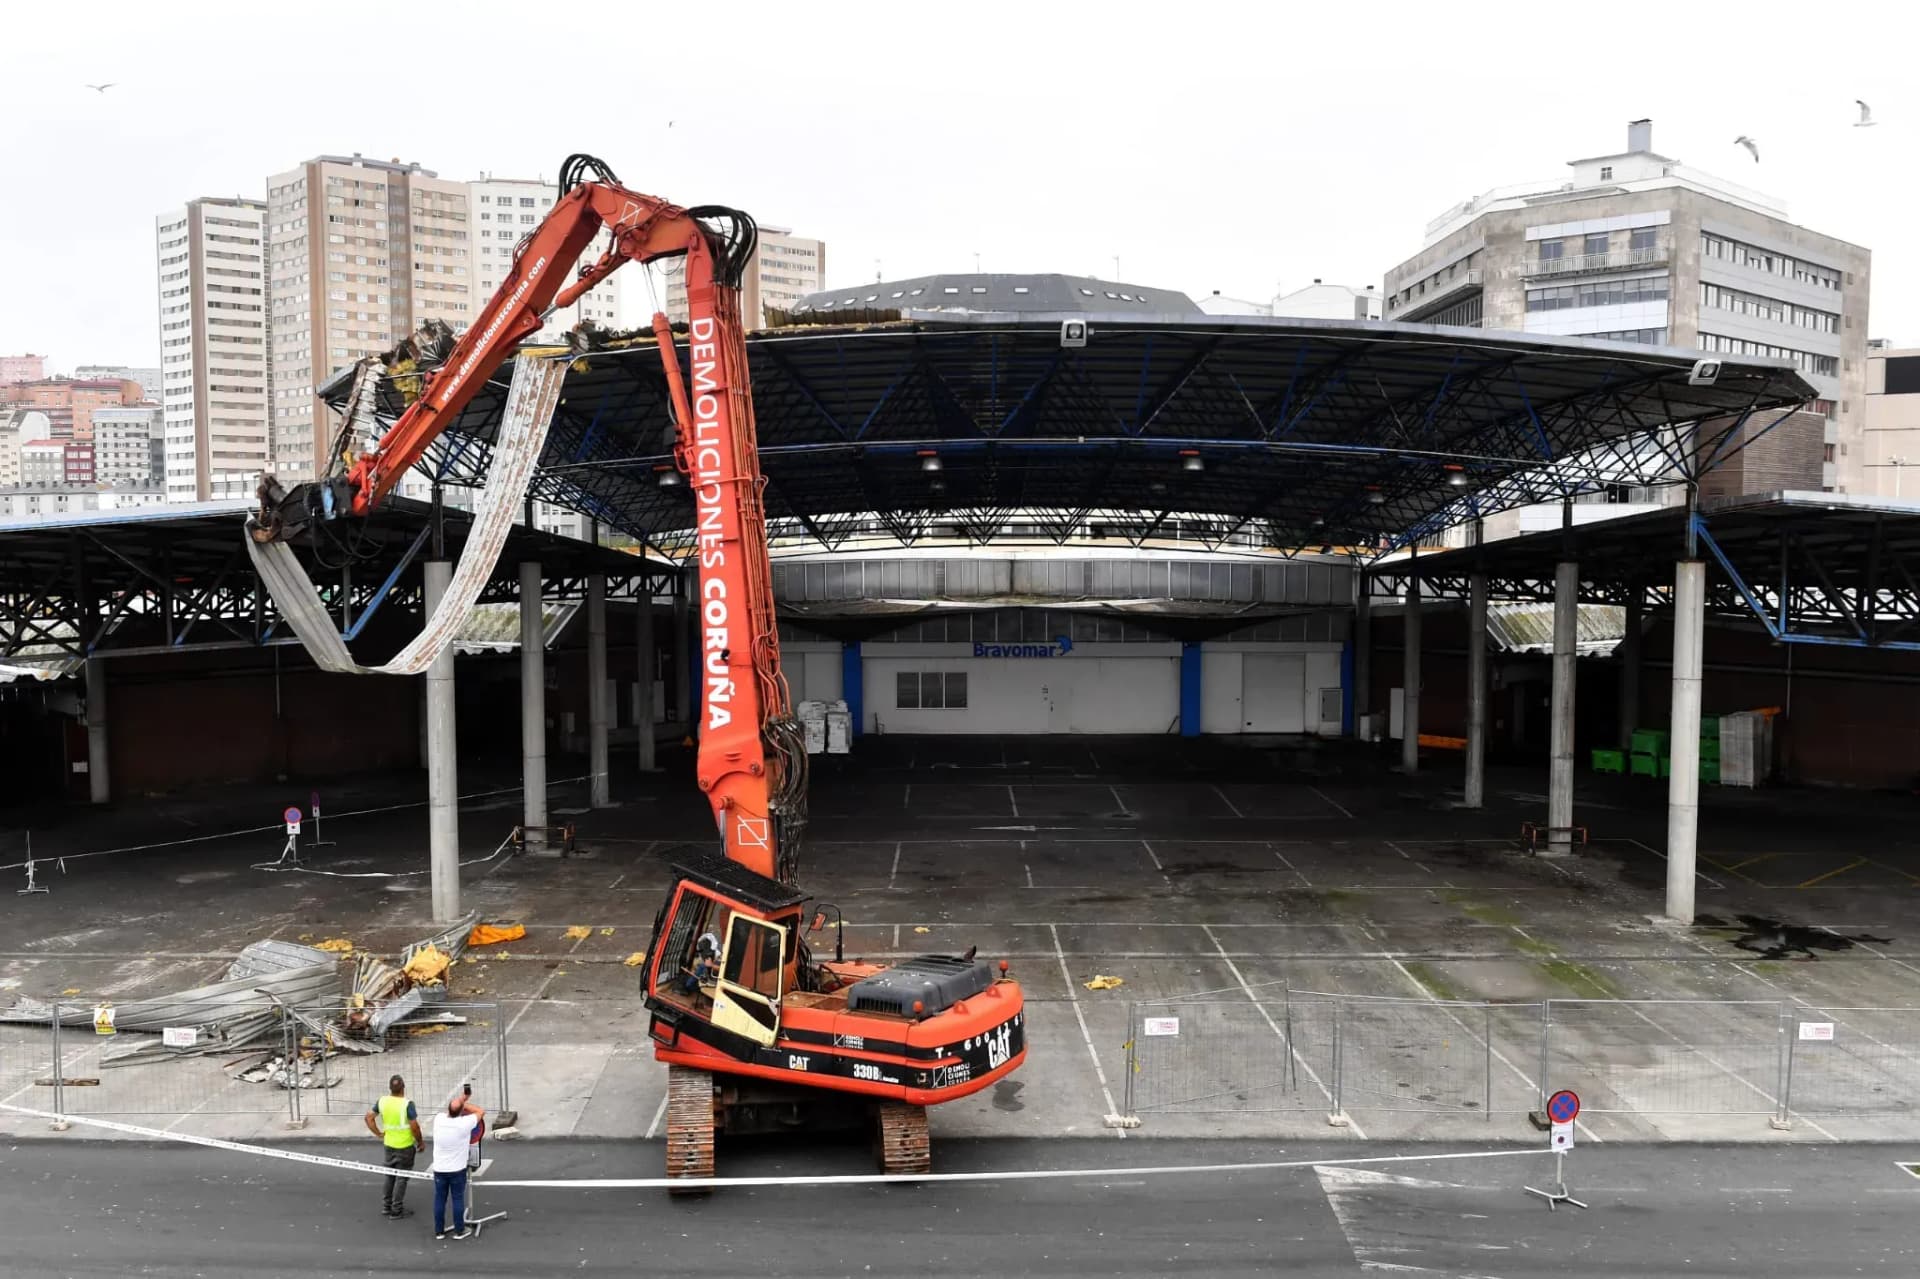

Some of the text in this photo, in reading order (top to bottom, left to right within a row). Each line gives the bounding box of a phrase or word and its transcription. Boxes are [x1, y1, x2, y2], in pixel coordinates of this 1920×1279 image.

[441, 256, 546, 402] www.demolicionescorunacom
[692, 317, 736, 730] DEMOLICIONES CORUÑA
[973, 642, 1056, 657] Bravomar
[789, 1055, 810, 1070] CAT
[988, 1028, 1011, 1069] CAT
